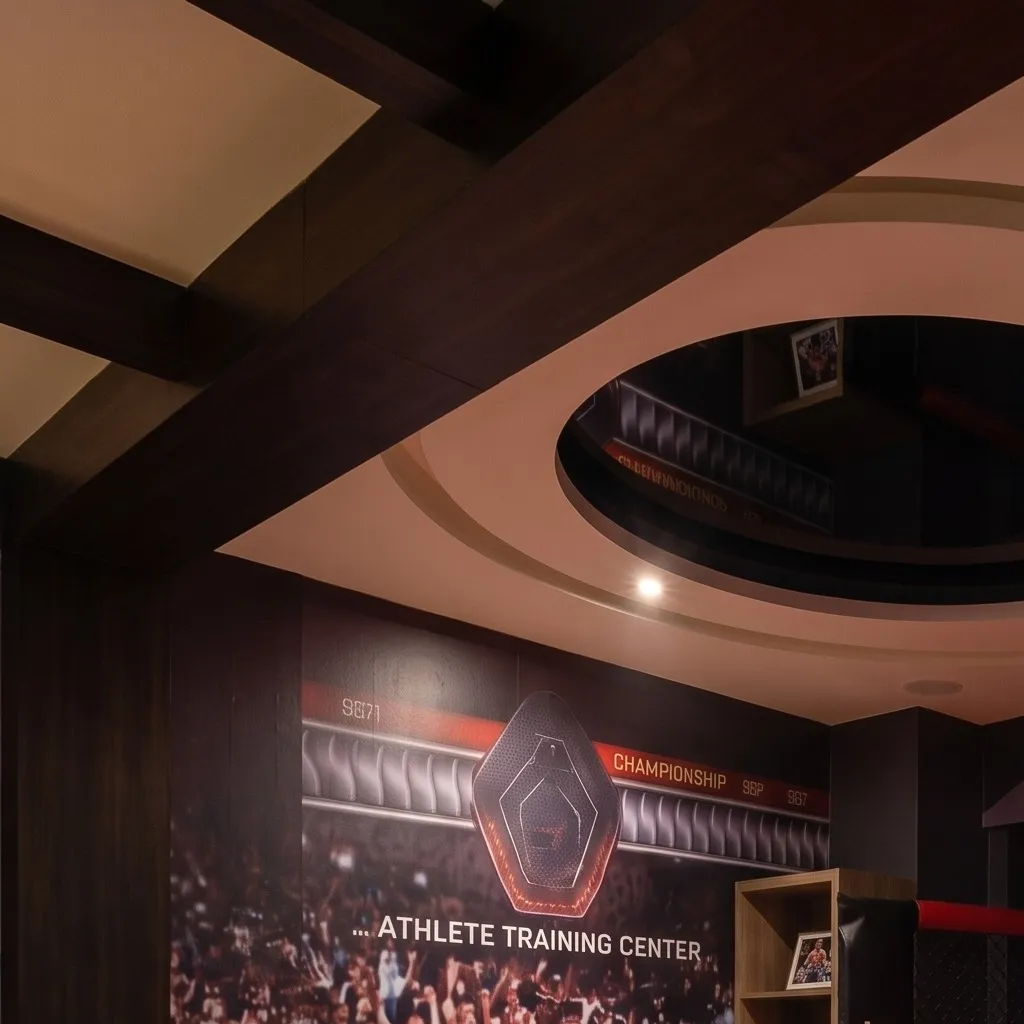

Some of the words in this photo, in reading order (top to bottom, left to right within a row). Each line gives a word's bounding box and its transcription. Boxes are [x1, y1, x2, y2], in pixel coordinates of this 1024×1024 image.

[613, 753, 727, 790] CHAMPIONSHIP
[377, 915, 495, 946] ATHLETE
[501, 925, 612, 955] TRAINING
[619, 935, 702, 962] CENTER
